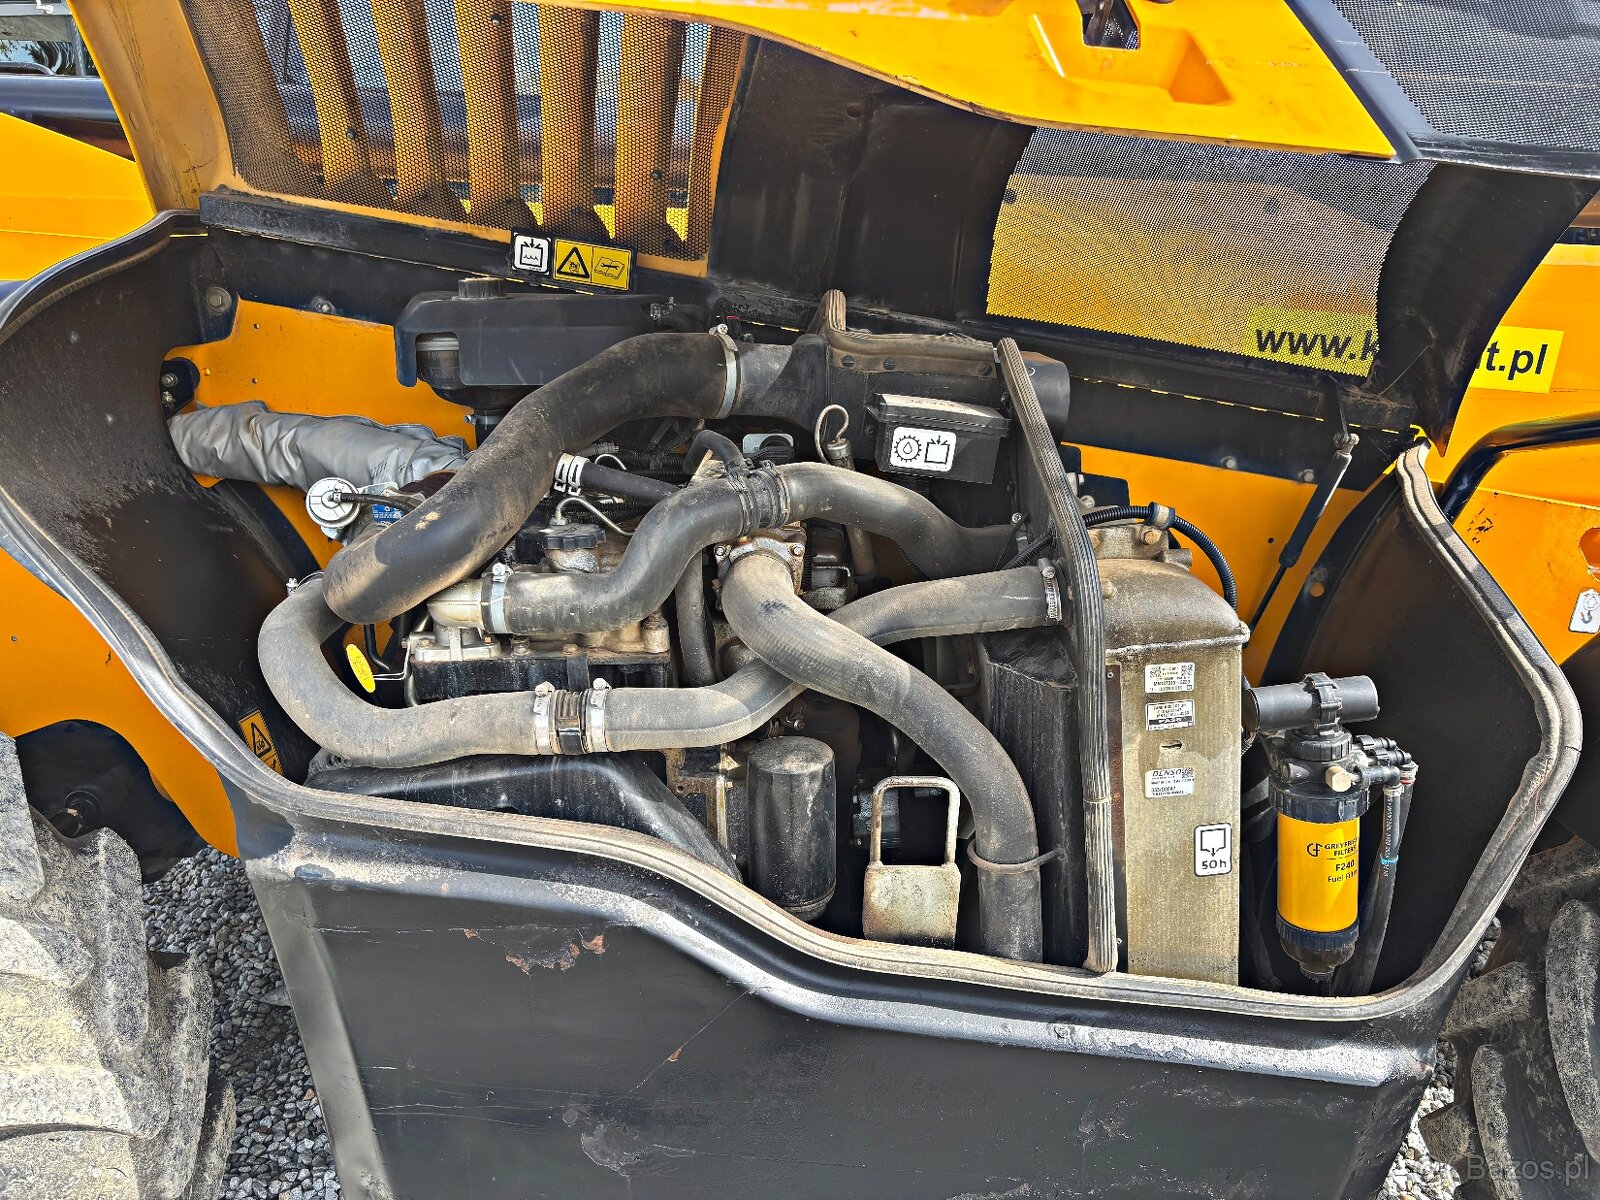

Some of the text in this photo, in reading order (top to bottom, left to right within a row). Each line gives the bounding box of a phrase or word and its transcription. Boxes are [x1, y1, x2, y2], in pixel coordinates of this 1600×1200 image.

[1475, 340, 1549, 381] t.pl
[1335, 859, 1355, 872] F240
[1327, 874, 1344, 883] Fuel
